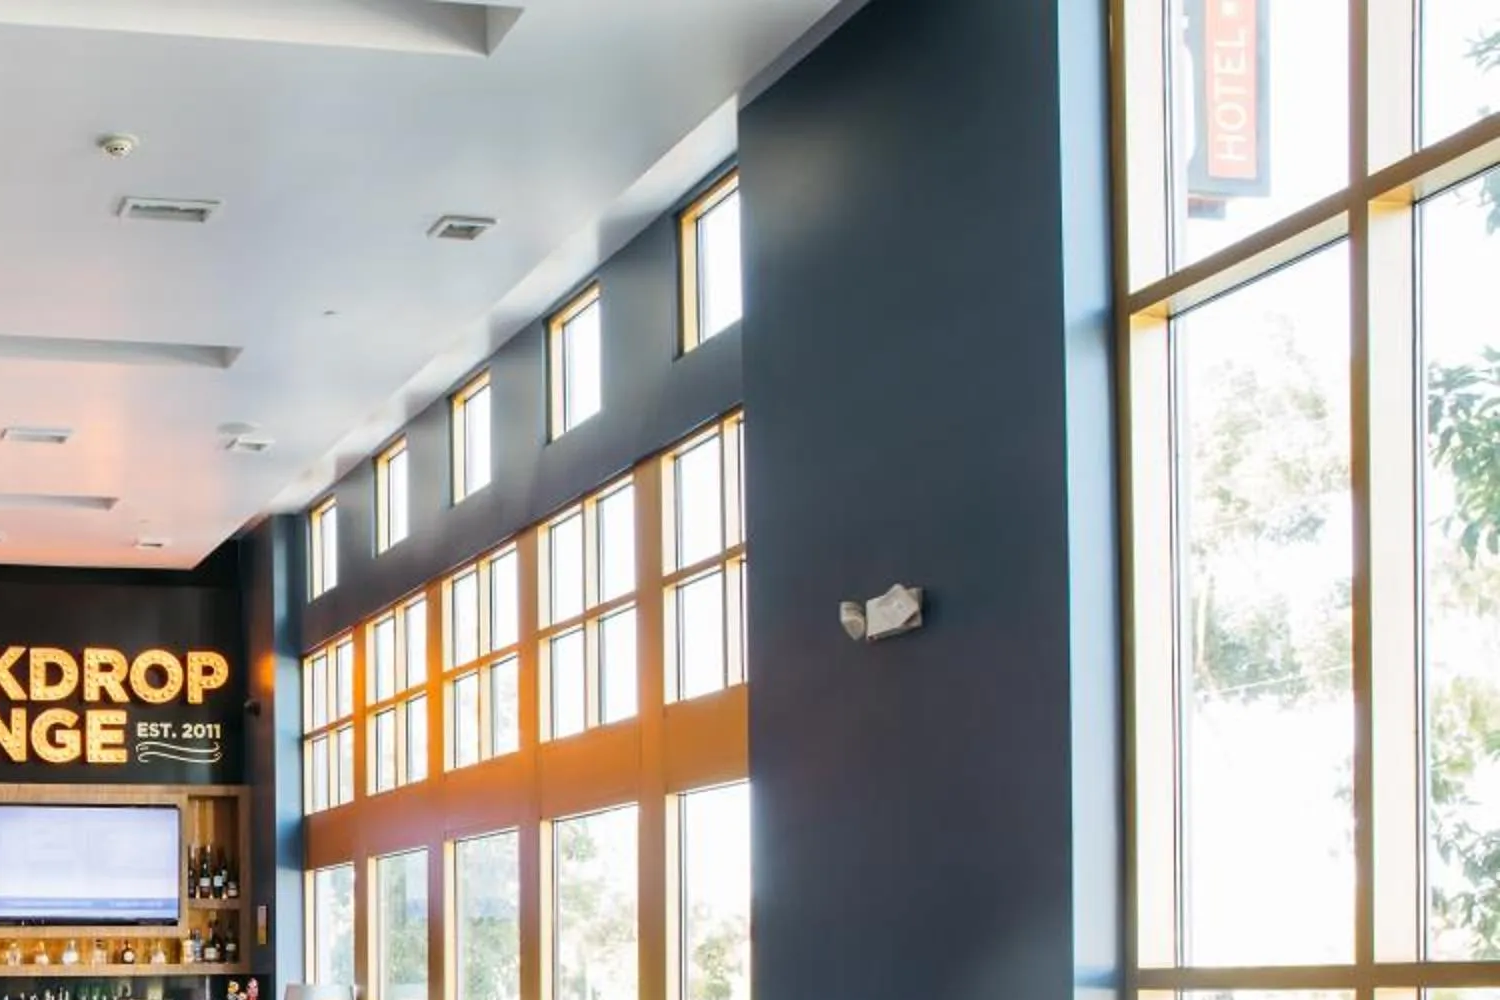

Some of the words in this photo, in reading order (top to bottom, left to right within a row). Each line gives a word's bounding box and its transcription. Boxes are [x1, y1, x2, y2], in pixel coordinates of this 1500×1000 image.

[1214, 28, 1247, 162] HOTEL
[137, 721, 177, 739] EST.
[181, 723, 221, 739] 2011
